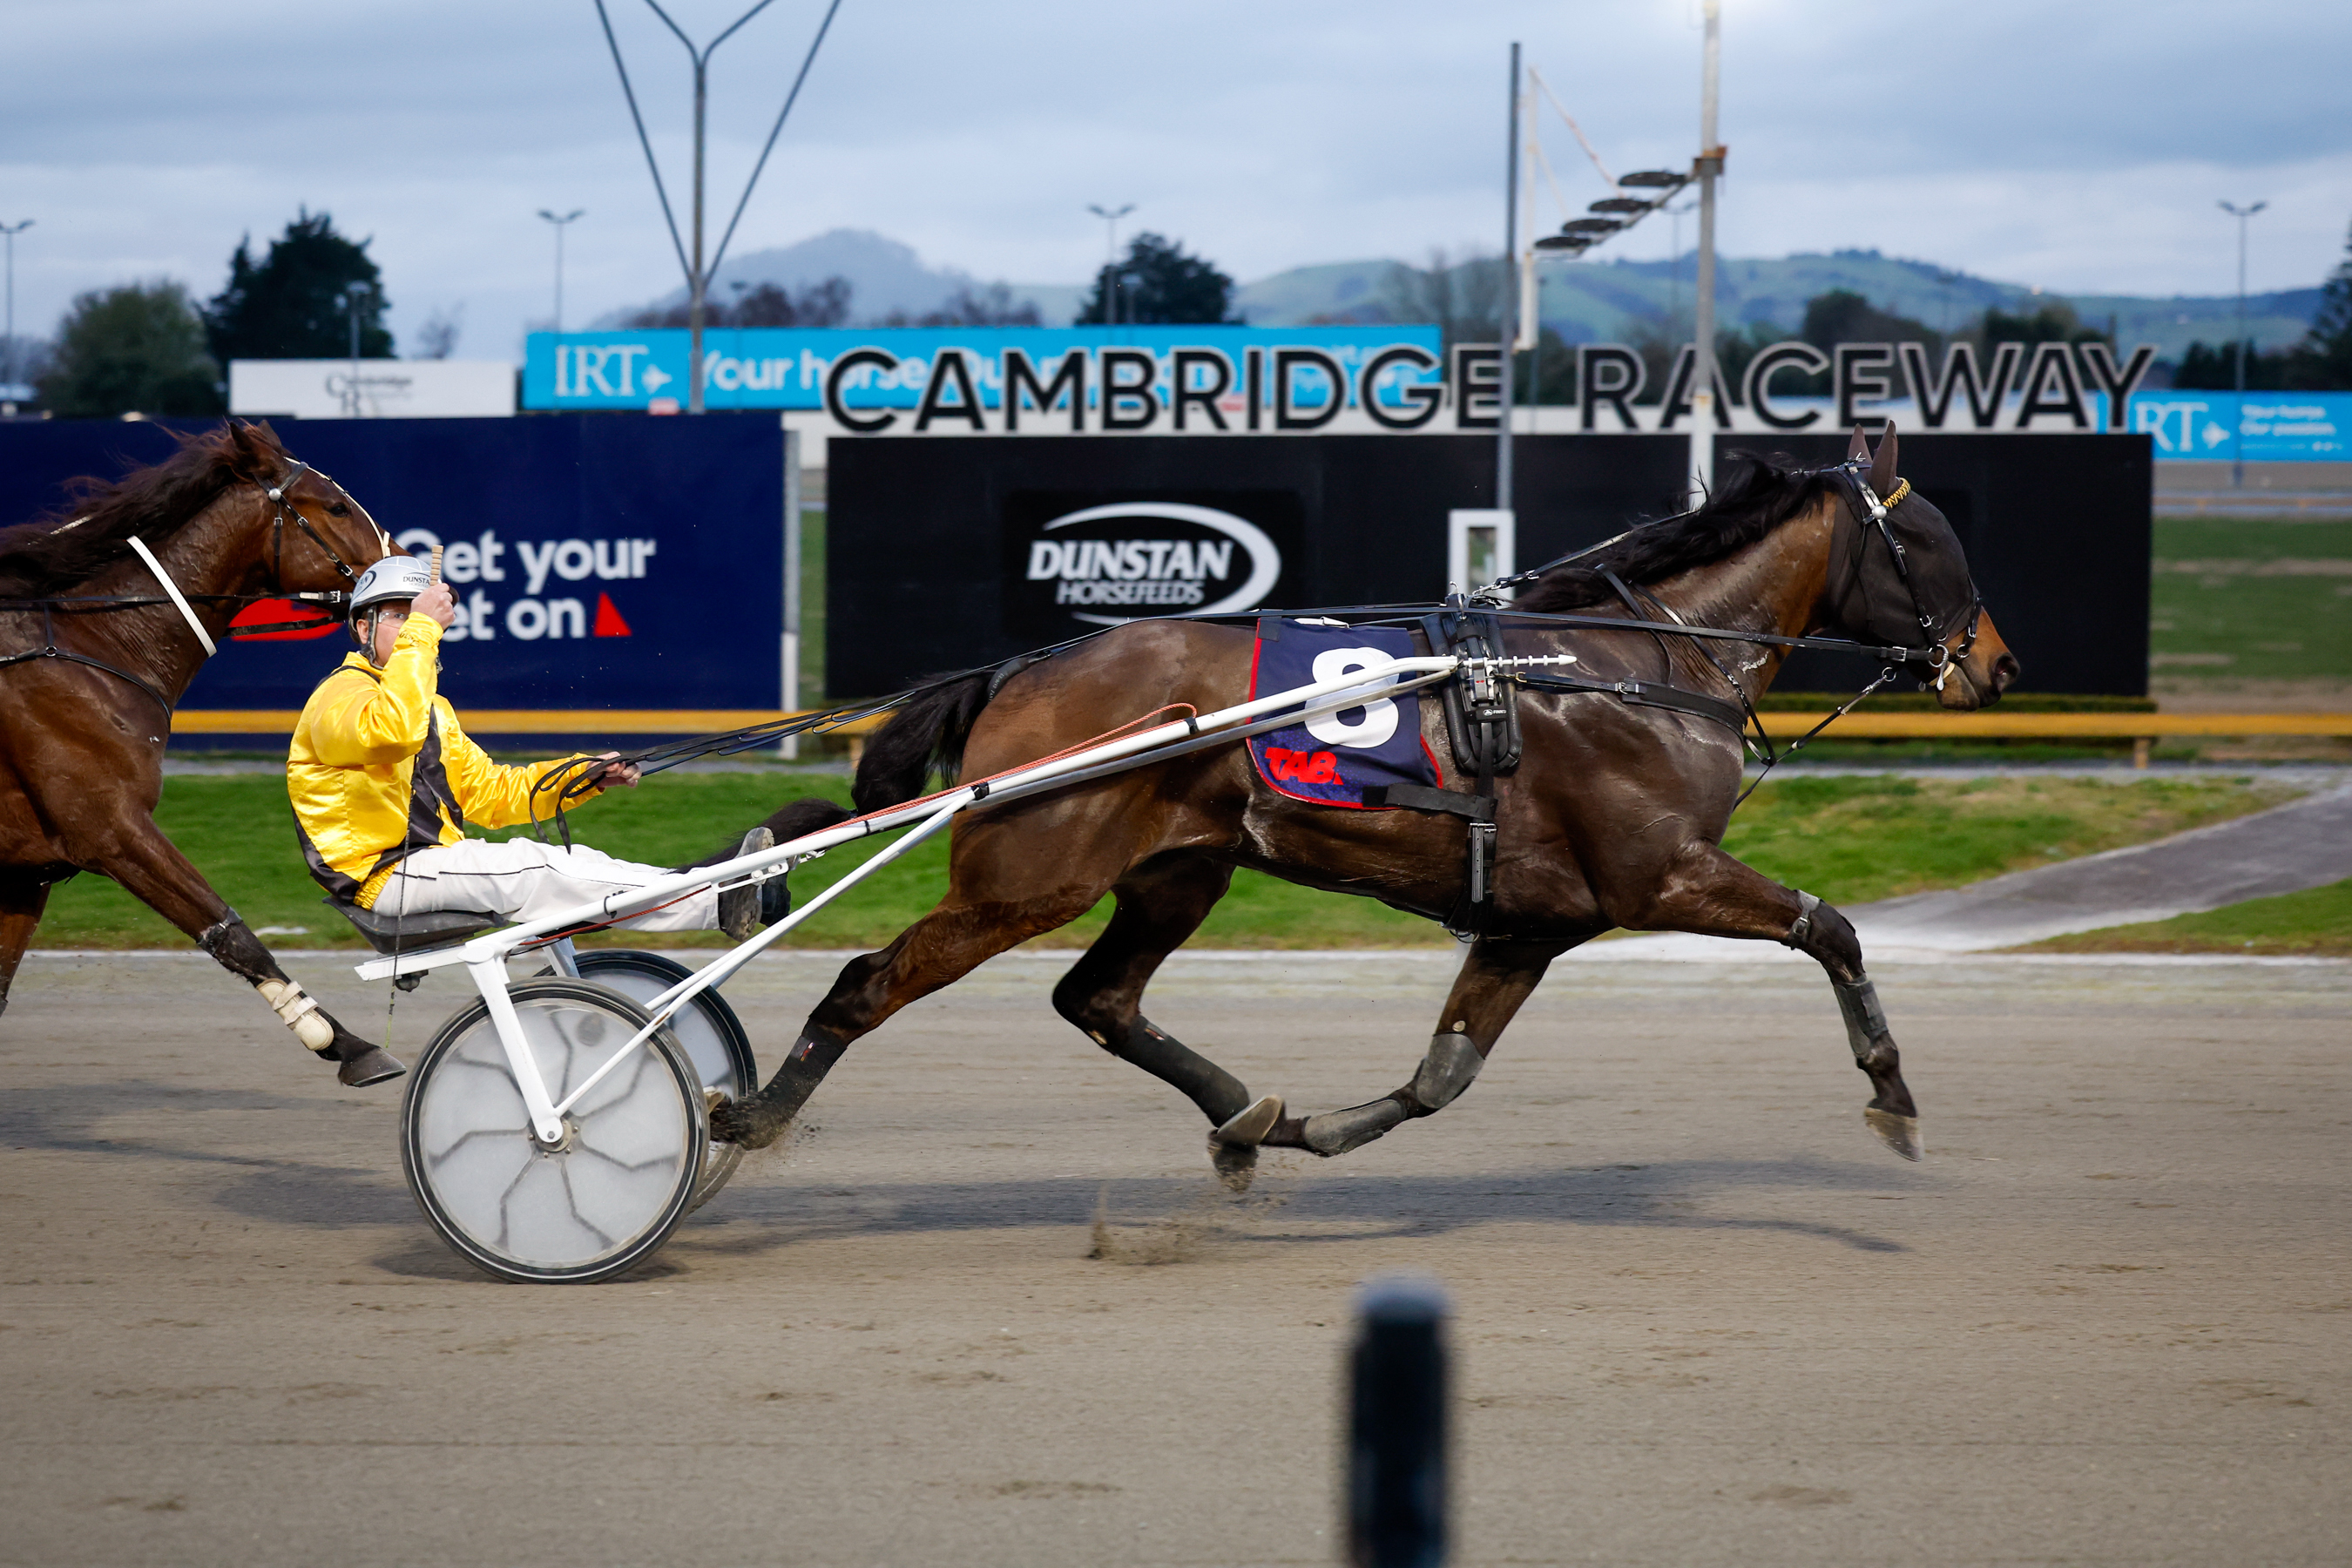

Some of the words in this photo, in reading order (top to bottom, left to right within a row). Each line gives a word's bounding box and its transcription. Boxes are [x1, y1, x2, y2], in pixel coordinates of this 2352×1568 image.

[555, 344, 650, 396] IRT
[824, 343, 1507, 436] CAMBRIDGE
[1577, 341, 2160, 433] RACEWAY
[2132, 402, 2209, 451] RT
[402, 576, 430, 585] DUNSTA
[516, 537, 657, 595] your
[1026, 539, 1234, 580] DUNSTAN
[446, 589, 496, 642] et
[505, 597, 586, 641] on
[1055, 581, 1206, 605] HORSEFEEDS
[1304, 646, 1400, 748] 8
[1265, 747, 1338, 784] TAB
